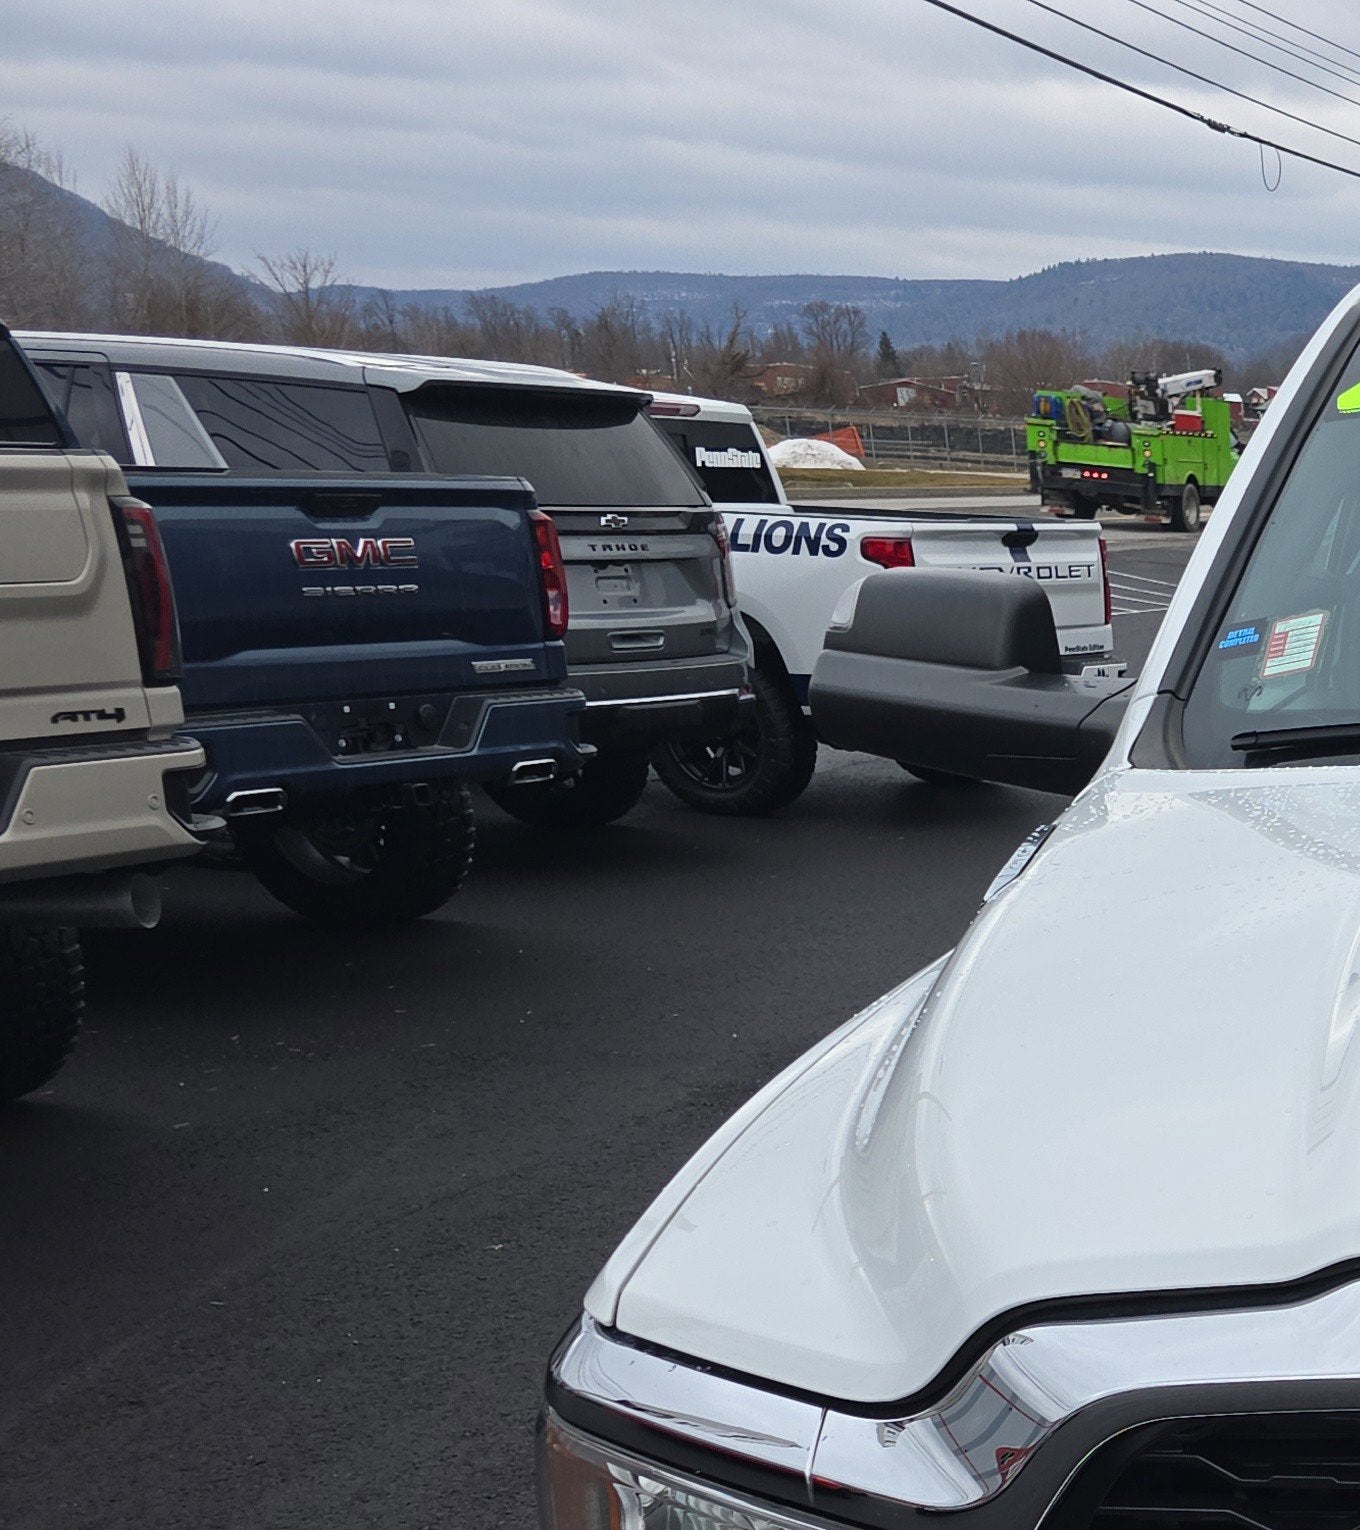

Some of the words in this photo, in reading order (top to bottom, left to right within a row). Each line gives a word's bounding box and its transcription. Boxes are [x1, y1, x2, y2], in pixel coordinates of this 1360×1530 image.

[588, 544, 650, 552] TAHOE
[730, 518, 851, 558] LIONS
[290, 537, 419, 569] GMC
[49, 707, 126, 724] AT4
